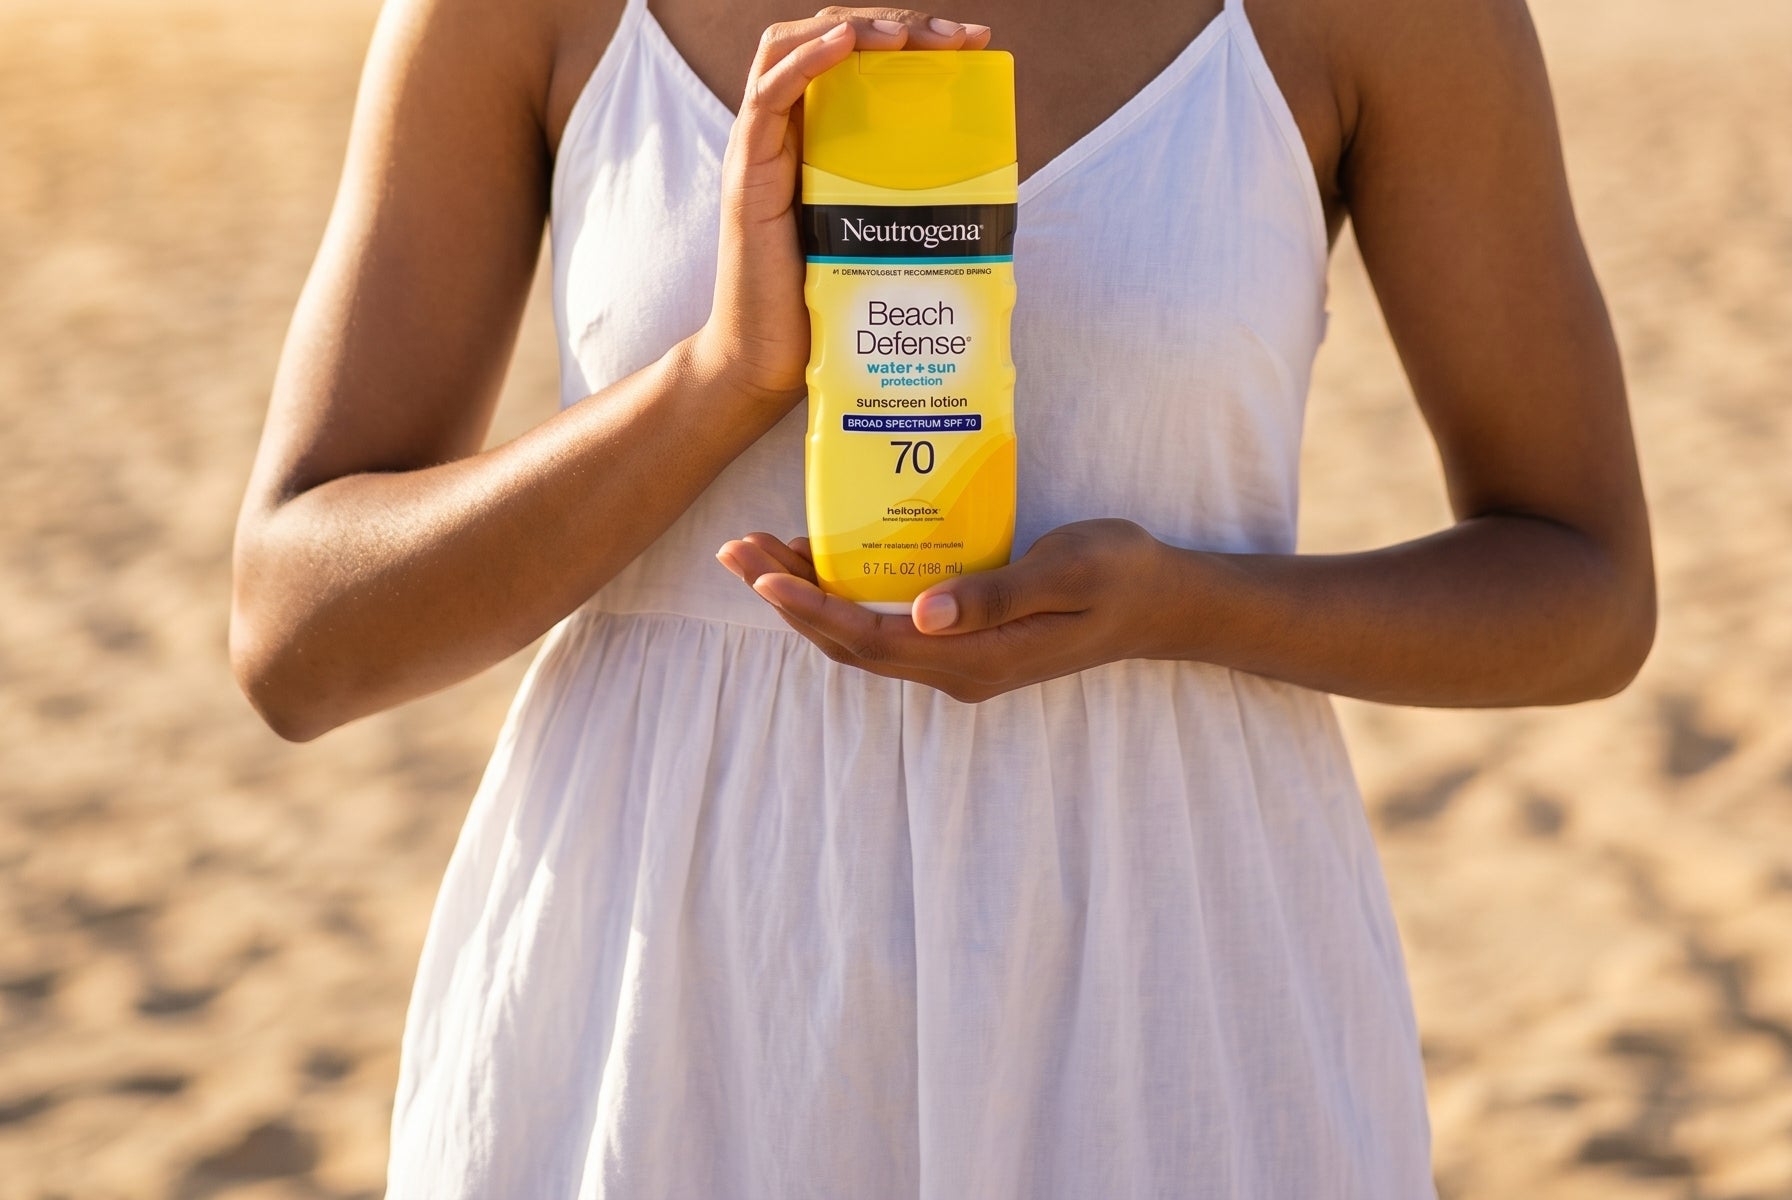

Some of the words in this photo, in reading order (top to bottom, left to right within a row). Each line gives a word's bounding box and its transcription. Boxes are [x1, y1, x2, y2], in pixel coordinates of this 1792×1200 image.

[841, 218, 981, 248] Neutrogena
[868, 301, 953, 326] Beach
[867, 362, 912, 374] water
[928, 363, 956, 374] sun
[881, 376, 943, 388] protection
[857, 398, 926, 408] sunscreen
[930, 396, 968, 408] lotion
[848, 418, 883, 428] BROAD
[885, 419, 941, 429] SPECTRUM
[943, 418, 963, 428] SPF
[965, 418, 977, 427] 70
[890, 441, 935, 474] 70
[883, 563, 896, 575] FL
[900, 563, 915, 575] OZ
